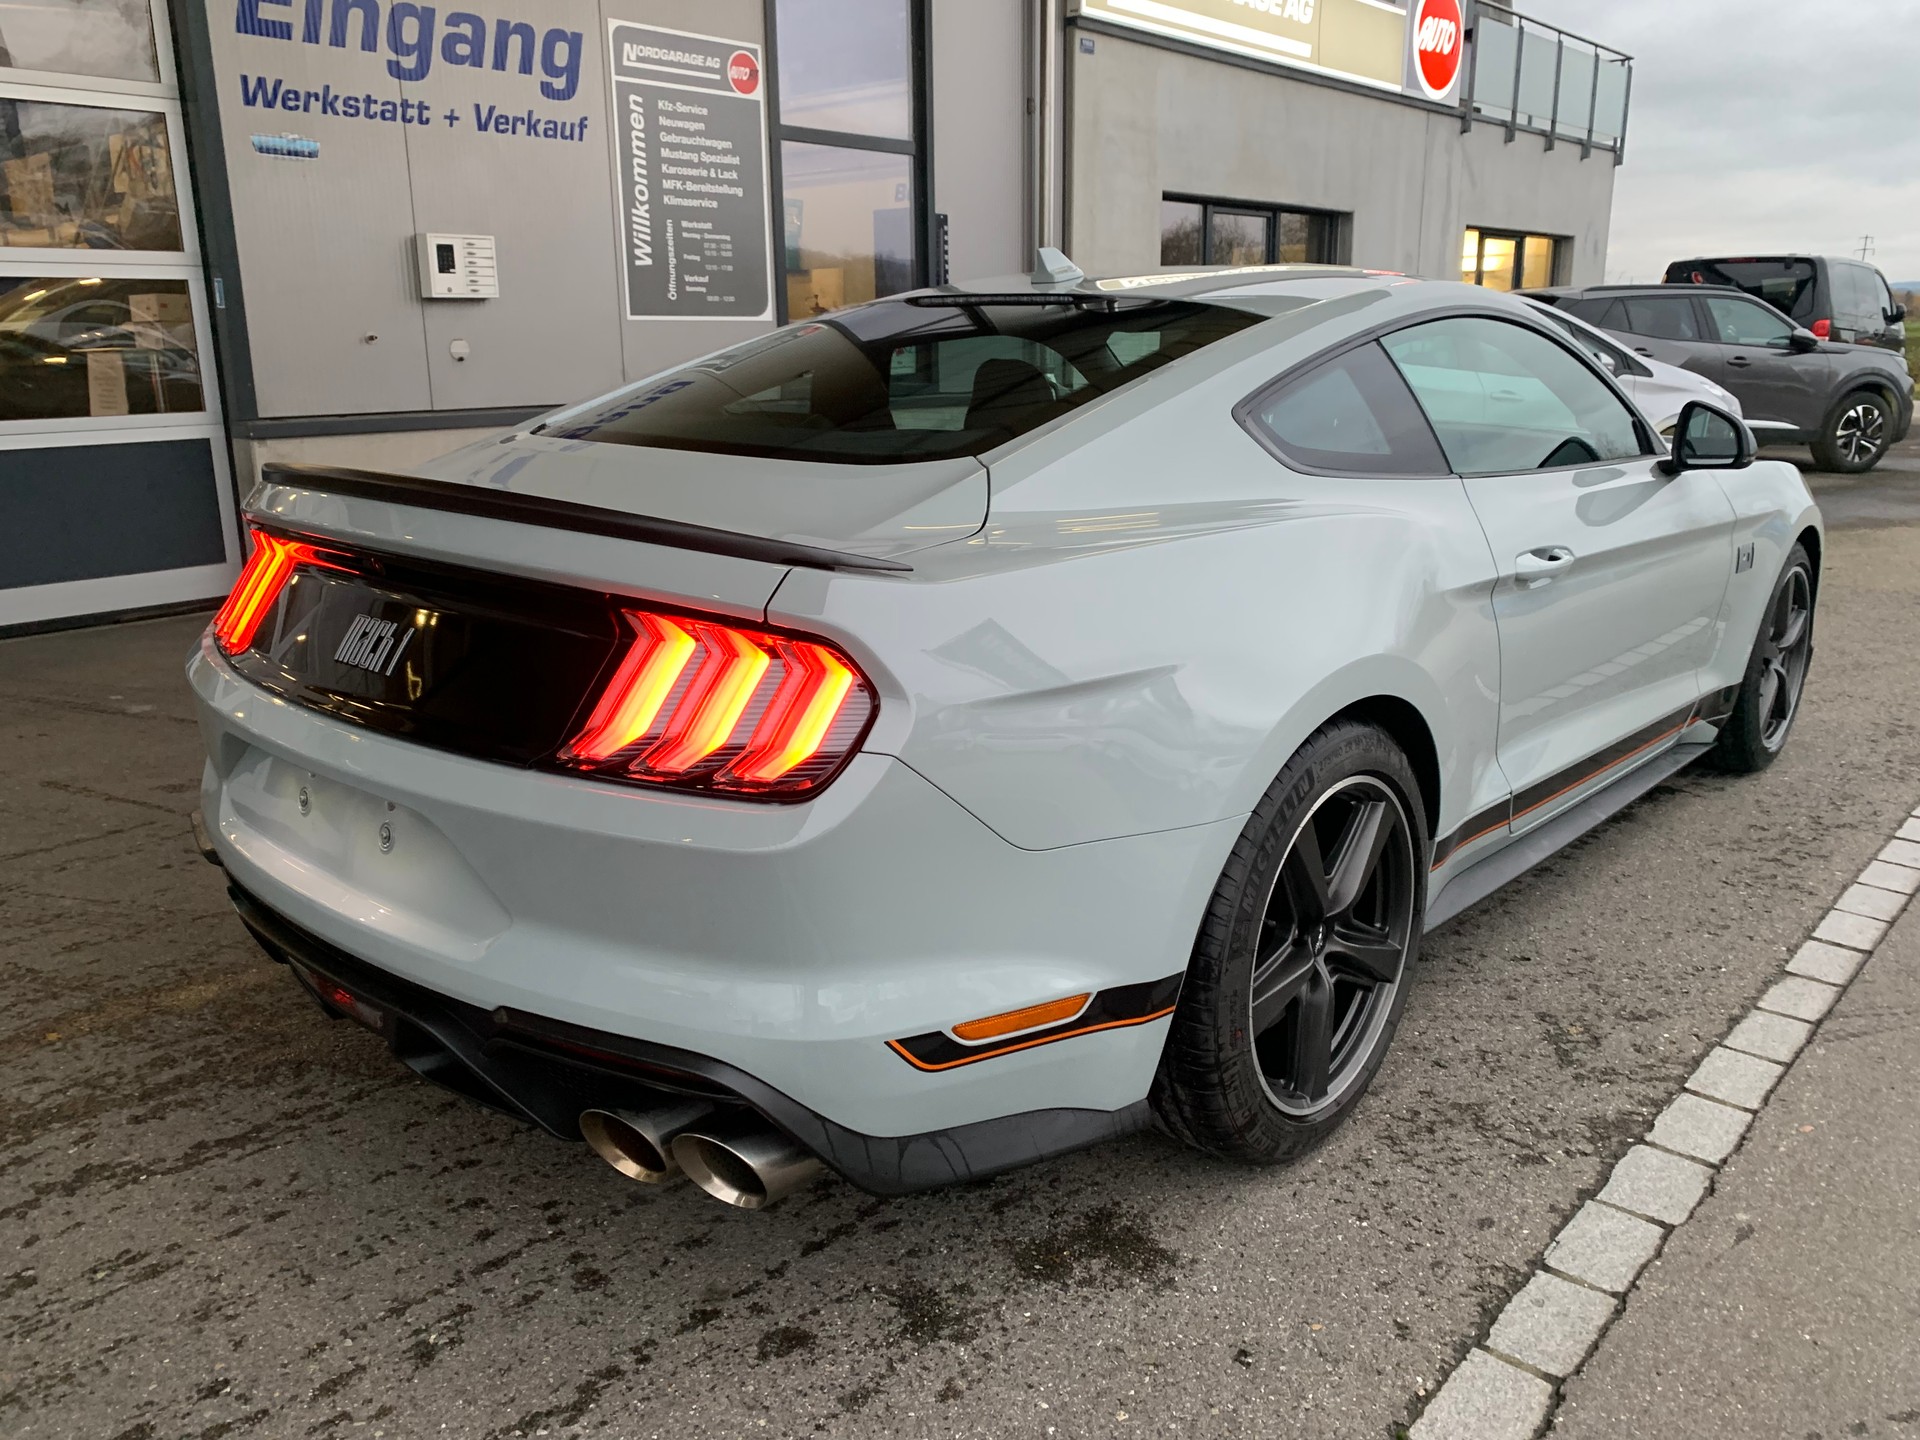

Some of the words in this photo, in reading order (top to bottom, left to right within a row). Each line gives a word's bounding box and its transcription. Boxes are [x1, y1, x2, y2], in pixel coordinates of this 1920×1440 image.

[623, 42, 704, 65] NORDGARAGE
[705, 56, 721, 69] AG
[239, 74, 431, 126] Werkstatt
[443, 108, 460, 128] +
[473, 103, 589, 142] Verkauf
[657, 99, 709, 115] Kfz-Service
[658, 115, 706, 131] Neuwagen
[659, 131, 733, 150] Gebrauchtwagen
[660, 147, 699, 163] Mustang
[700, 151, 740, 165] Spezialist
[629, 94, 653, 266] Willkommen
[661, 163, 708, 177] Karosserie
[717, 169, 738, 180] Lack
[662, 179, 744, 197] MFK-Bereitstellung
[663, 195, 719, 209] Klimaservice
[665, 219, 678, 301] Öffnungszeiten
[1241, 771, 1313, 914] MICHELIN
